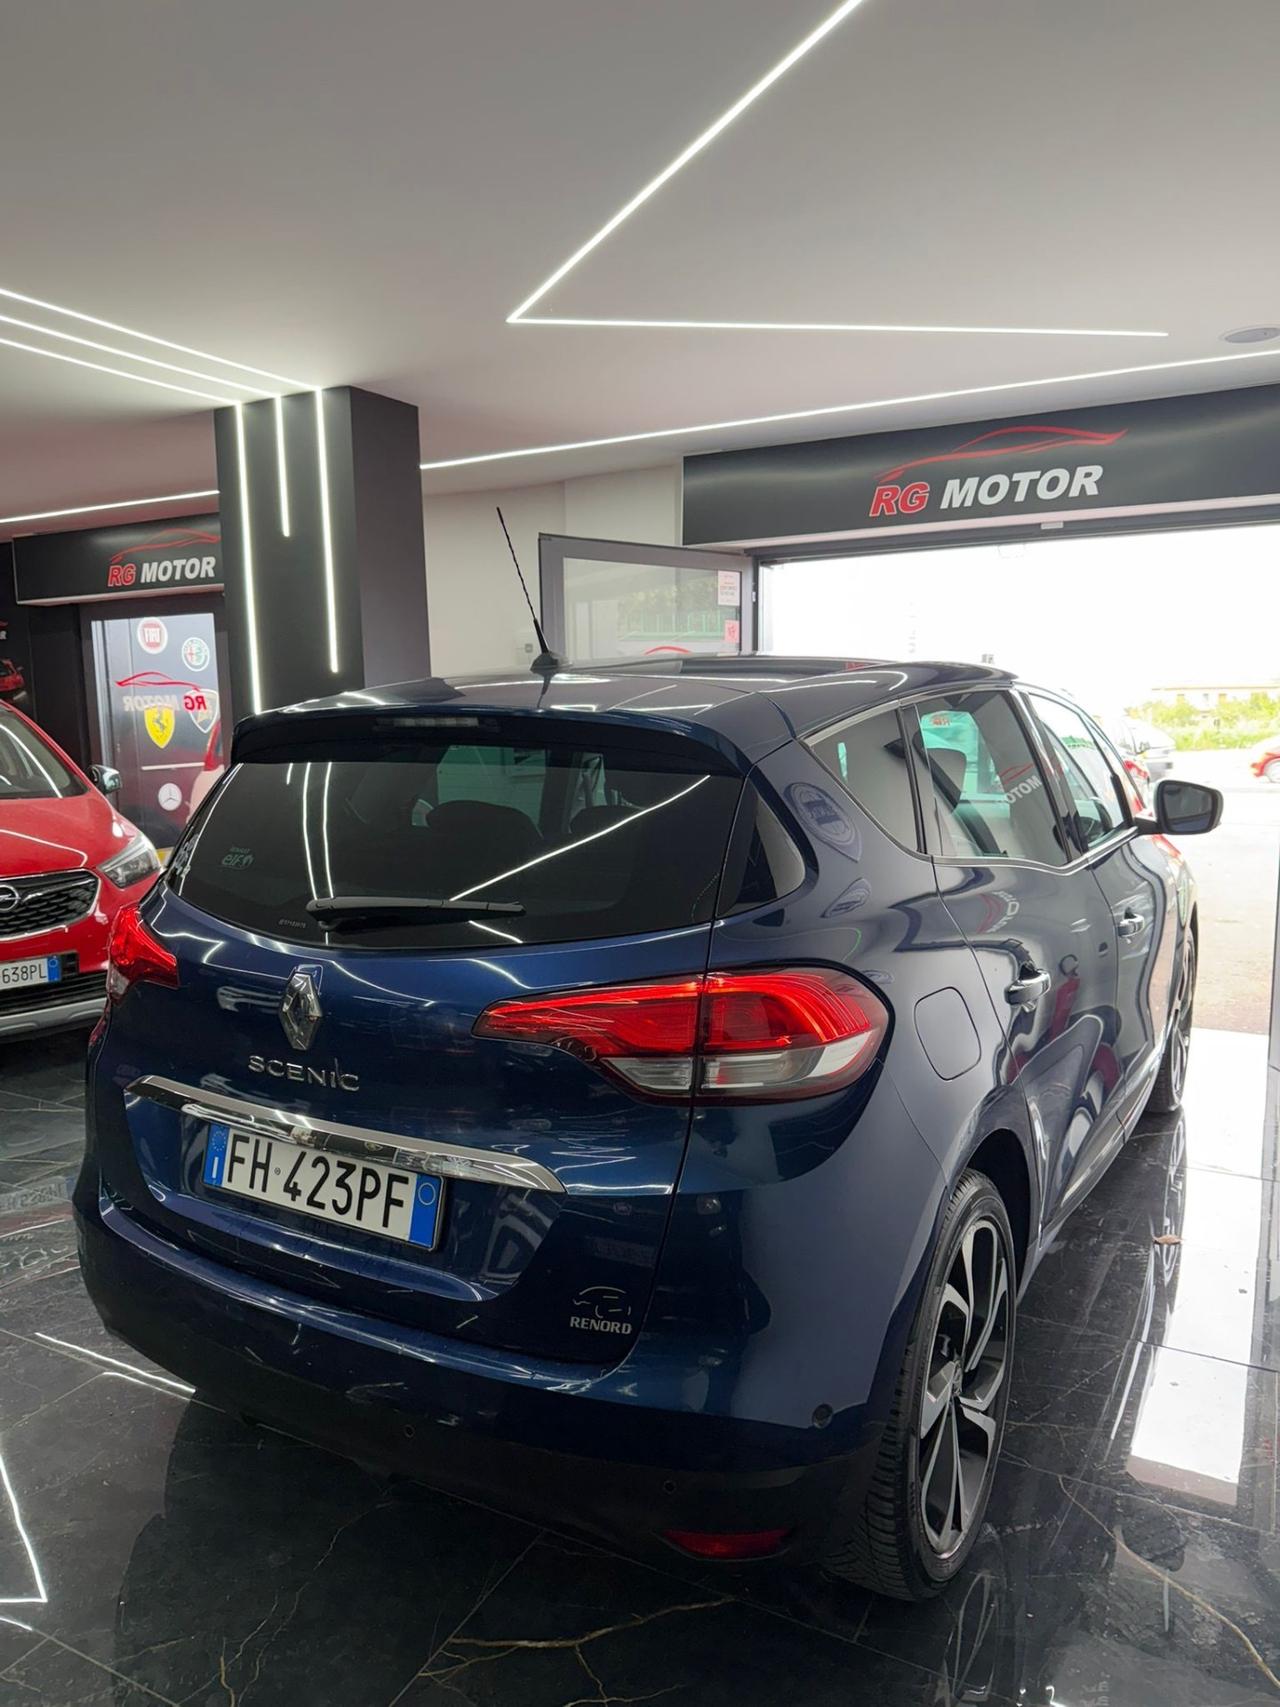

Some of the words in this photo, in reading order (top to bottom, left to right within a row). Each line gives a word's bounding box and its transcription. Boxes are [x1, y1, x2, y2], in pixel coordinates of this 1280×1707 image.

[869, 482, 930, 517] RG
[940, 465, 1104, 509] MOTOR
[107, 563, 136, 587] RG
[140, 556, 216, 583] MOTOR
[2, 964, 47, 984] 638PL
[248, 1055, 360, 1092] SCENIC
[227, 1133, 273, 1193] FH
[283, 1151, 409, 1228] 423PF
[570, 1316, 632, 1335] RENORD
